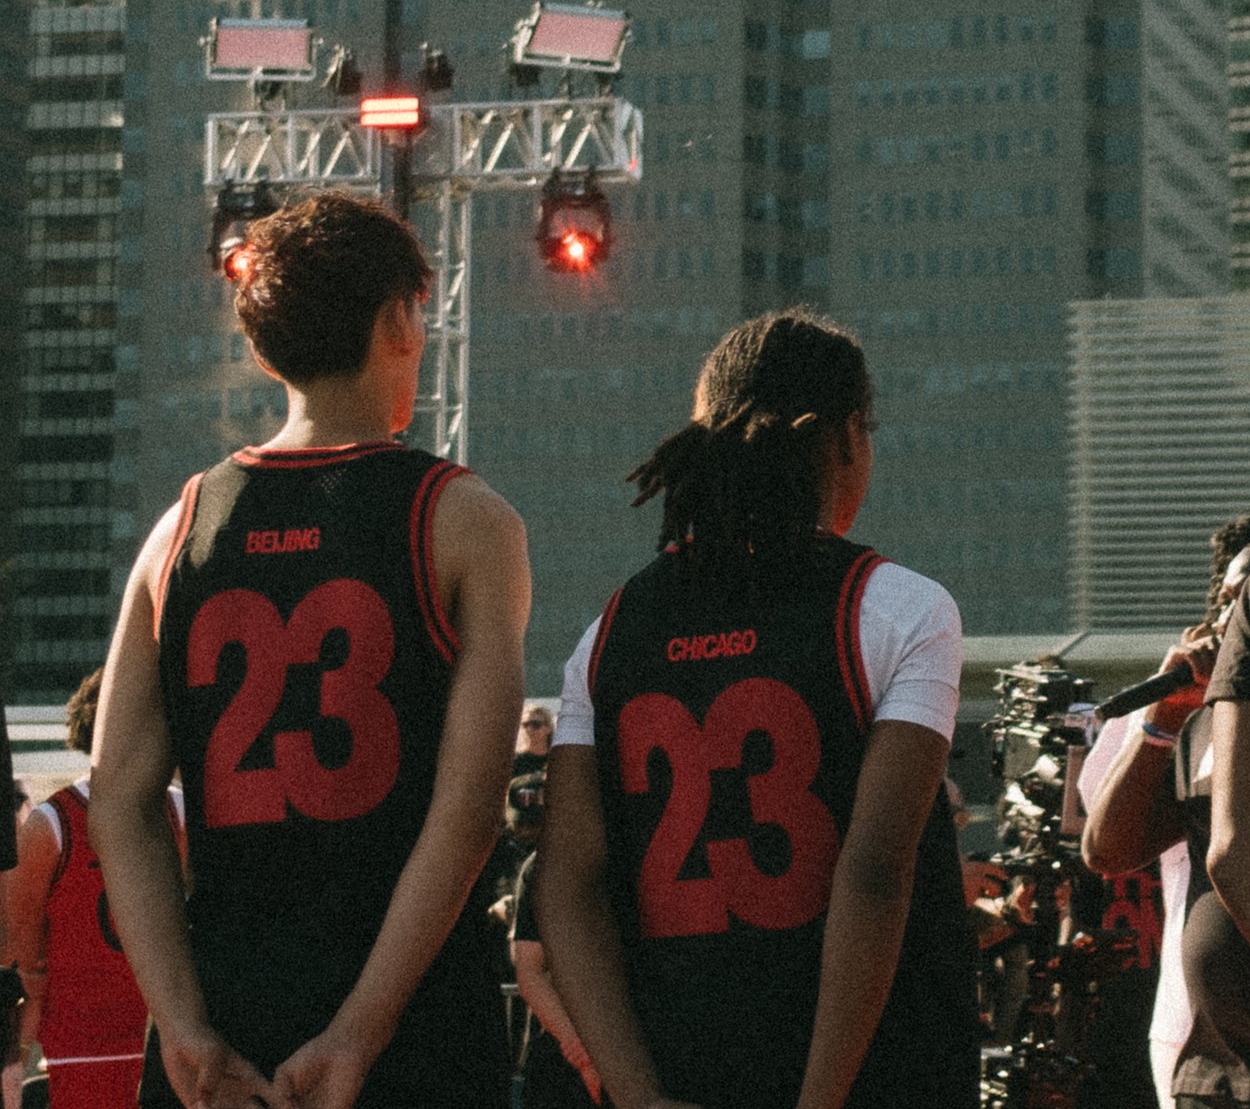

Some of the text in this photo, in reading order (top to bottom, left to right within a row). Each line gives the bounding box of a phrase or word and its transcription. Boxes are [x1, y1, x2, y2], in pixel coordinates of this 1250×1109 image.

[244, 527, 321, 554] BEIJING
[188, 578, 401, 827] 23
[667, 628, 757, 662] CHICAGO
[619, 678, 840, 939] 23
